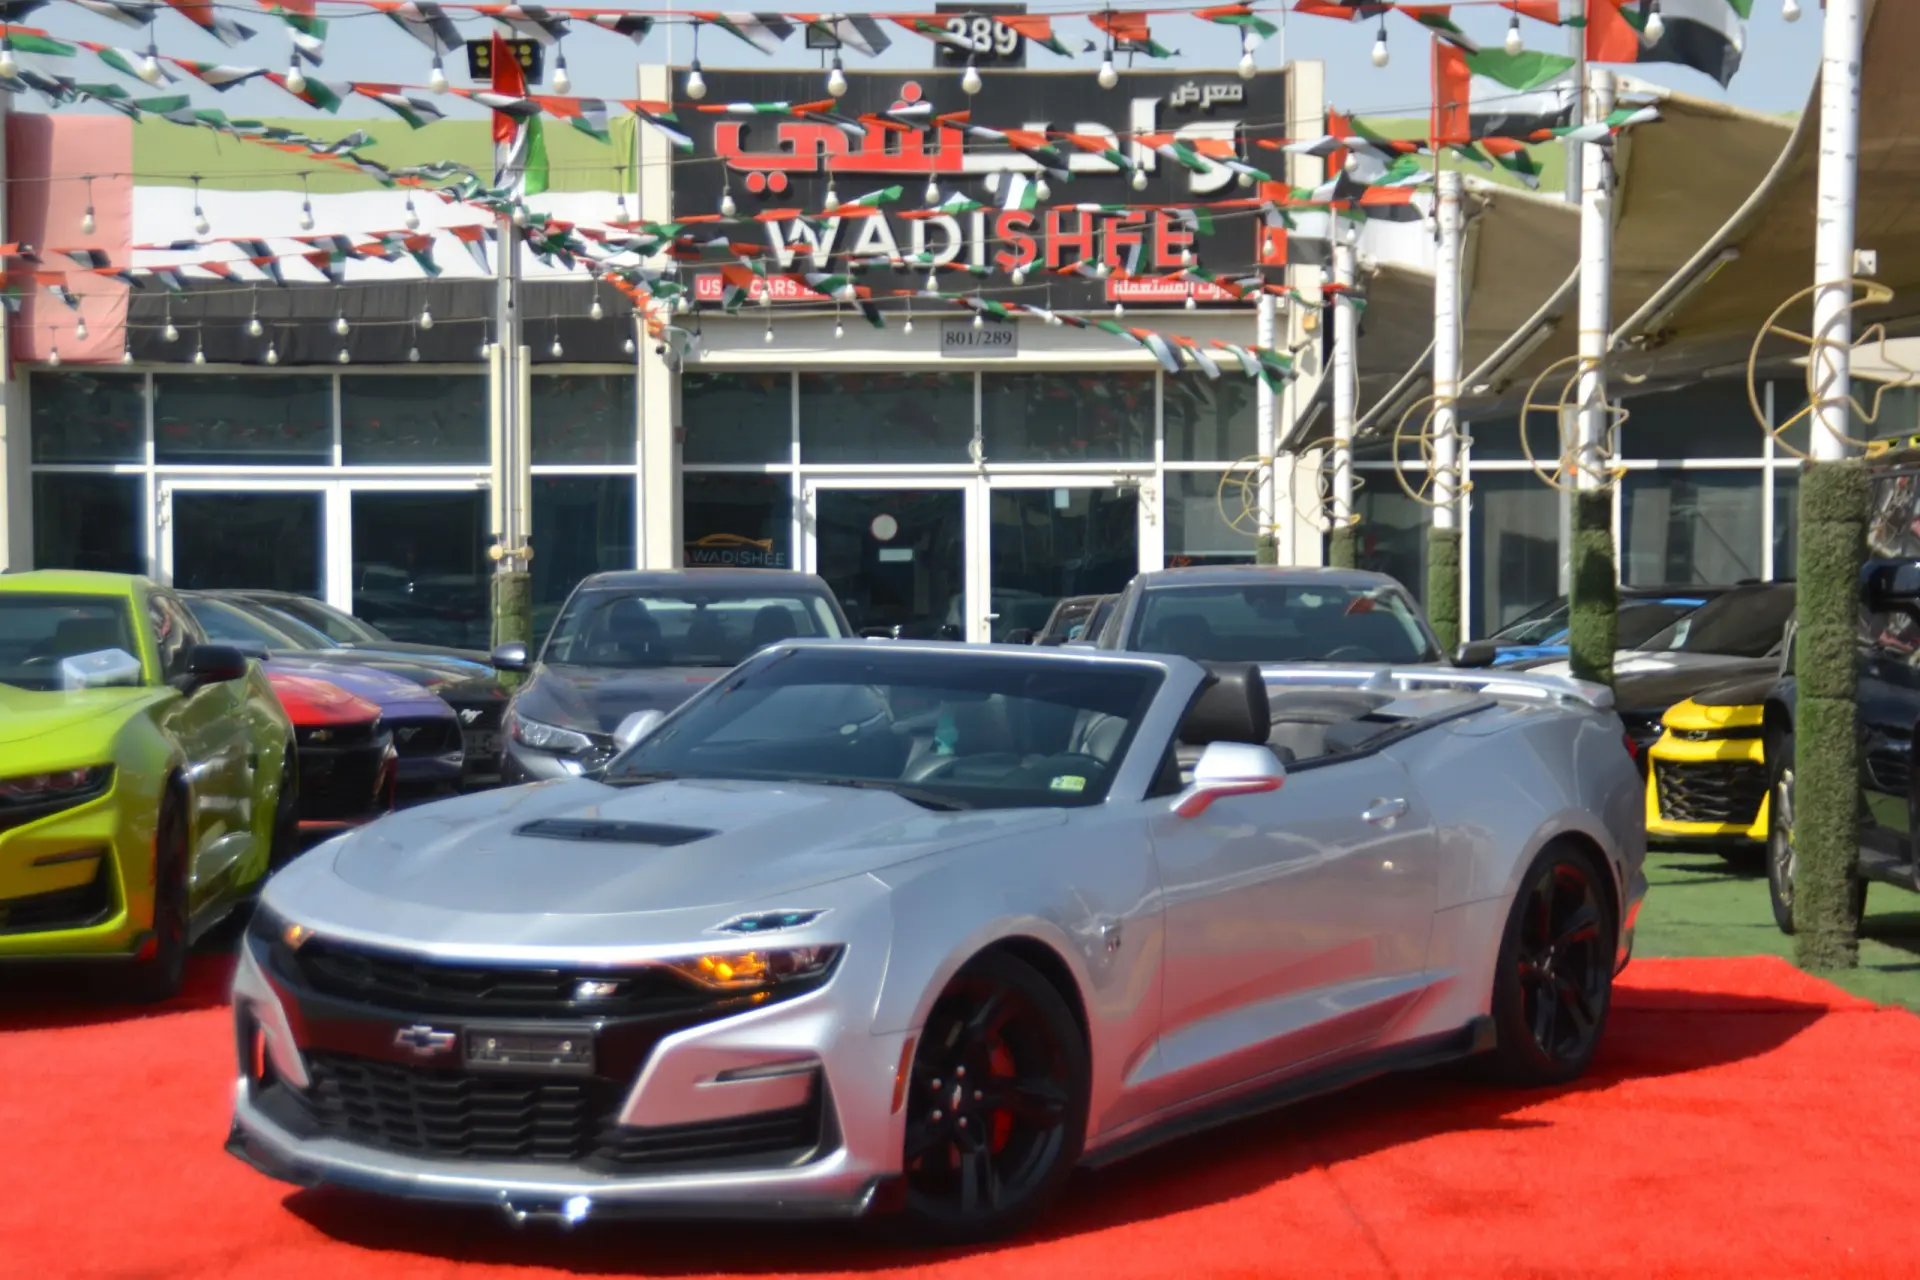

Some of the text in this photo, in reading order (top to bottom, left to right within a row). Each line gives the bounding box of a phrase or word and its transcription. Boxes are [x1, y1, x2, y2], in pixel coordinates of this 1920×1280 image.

[942, 16, 1018, 56] 289
[1170, 80, 1243, 107] معرض
[750, 279, 797, 295] CARS
[946, 331, 1013, 346] 801/289
[693, 549, 785, 566] WADISHEE
